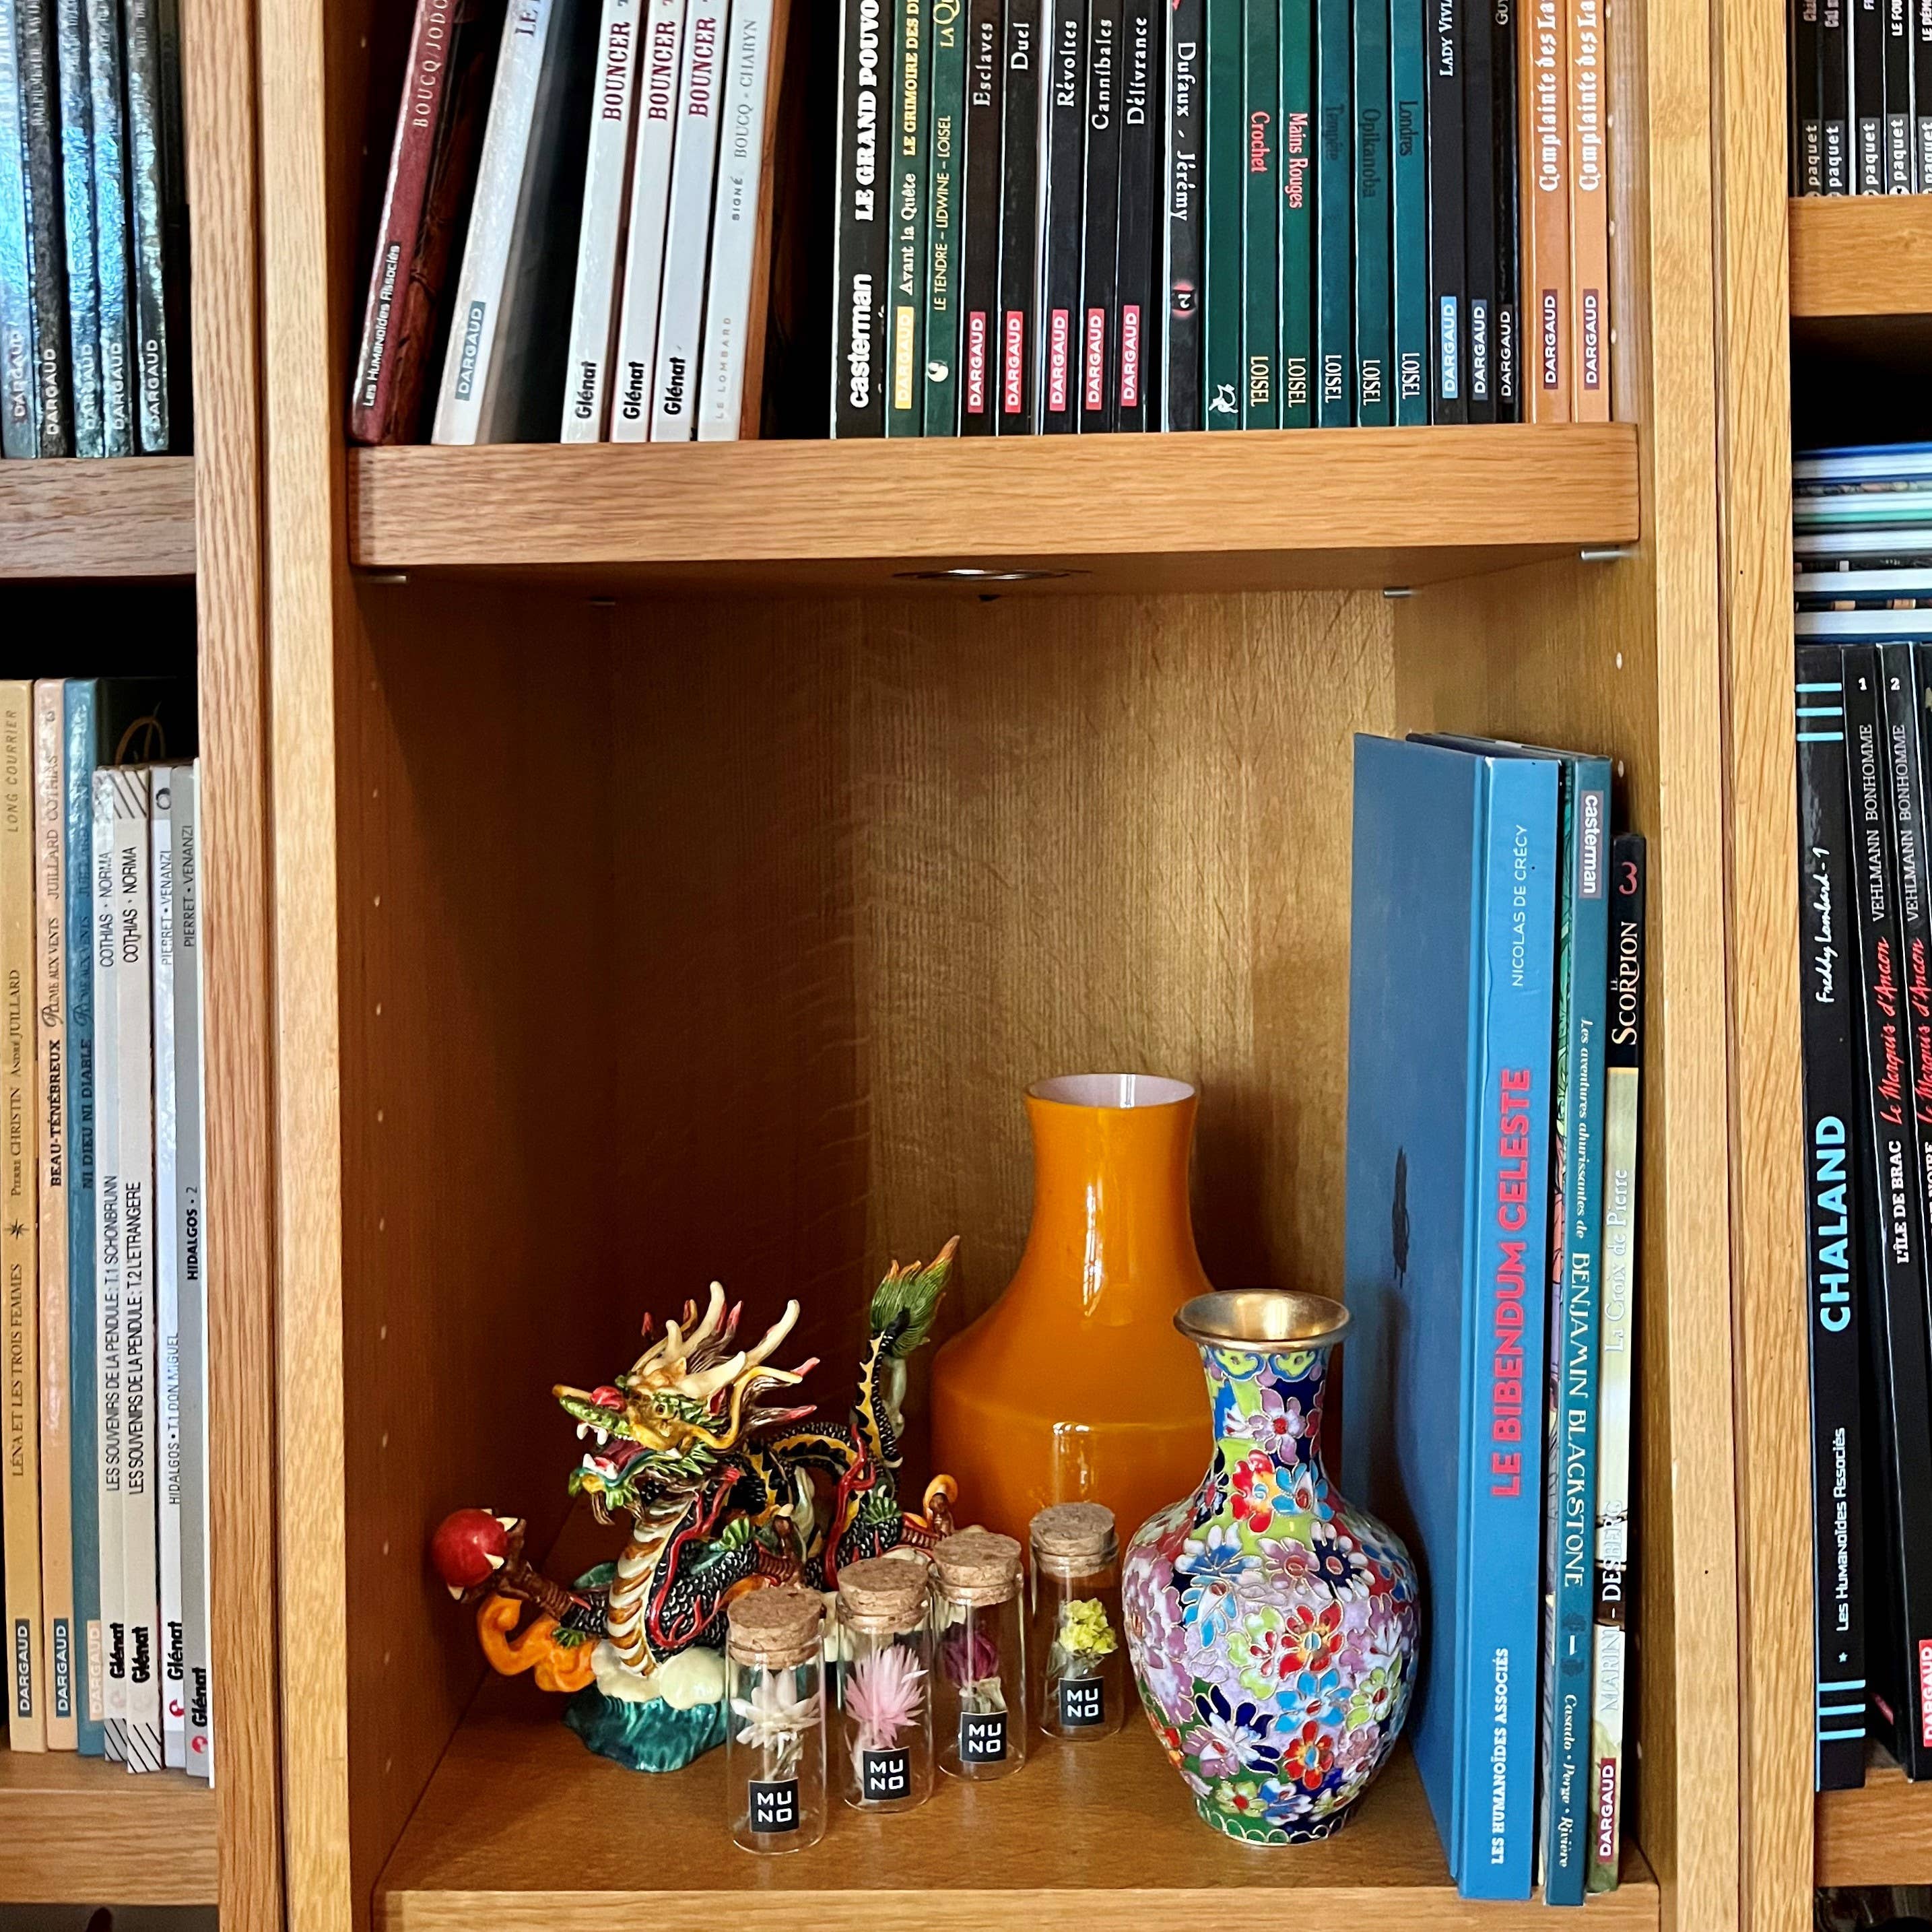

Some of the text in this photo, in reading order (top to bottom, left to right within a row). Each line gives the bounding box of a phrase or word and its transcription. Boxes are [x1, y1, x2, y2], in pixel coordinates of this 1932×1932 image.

[603, 22, 631, 121] BOUNCER
[648, 21, 676, 121] BOUNCER
[689, 17, 717, 117] BOUNCER
[940, 27, 954, 47] LA
[973, 22, 993, 106] Esclaves
[1011, 22, 1030, 71] Duel
[1056, 20, 1077, 107] Révoltes
[1126, 17, 1147, 125] Délivrance
[1440, 36, 1453, 77] LADY
[1891, 23, 1903, 36] LE
[734, 20, 757, 158] BOUCQ CHARYN
[855, 0, 879, 221] LE GRAND POUVO
[903, 18, 919, 156] LE GRIMOIRE DES
[1091, 19, 1112, 129] Cannibales
[1535, 34, 1562, 191] Complainte des
[1574, 32, 1602, 191] Complainte des
[1170, 42, 1196, 222] Dufaux Jérémy
[1251, 111, 1270, 173] Crochet
[1285, 112, 1308, 209] Mains Rouges
[1399, 101, 1418, 156] Londres
[1805, 125, 1820, 186] paquet
[1826, 125, 1842, 187] paquet
[1863, 123, 1879, 185] paquet
[1890, 119, 1907, 181] paquet
[899, 173, 916, 296] Avant la Quête
[934, 116, 951, 310] LE TENDRE LOISEL
[458, 308, 483, 394] DARGAUD
[719, 317, 731, 393] LOMBARD
[848, 273, 872, 408] casterman
[898, 314, 910, 402] DARGAUD
[970, 318, 984, 406] DARGAUD
[1007, 318, 1021, 406] DARGAUD
[1052, 315, 1065, 404] DARGAUD
[1088, 314, 1102, 403] DARGAUD
[1123, 312, 1137, 400] DARGAUD
[1250, 356, 1269, 407] LOISEL
[1288, 358, 1306, 408] LOISEL
[1325, 354, 1342, 403] LOISEL
[1362, 360, 1380, 406] LOISEL
[1401, 352, 1420, 400] LOISEL
[1443, 304, 1455, 392] DARGAUD
[1473, 306, 1486, 394] DARGAUD
[1500, 310, 1512, 397] DARGAUD
[1544, 295, 1556, 383] DARGAUD
[1585, 295, 1597, 384] DARGAUD
[43, 349, 59, 435] DARGAUD
[81, 343, 96, 430] DARGAUD
[110, 343, 125, 430] DARGAUD
[145, 339, 161, 432] DARGAUD
[575, 360, 597, 419] Glénat
[623, 361, 644, 420] Glénat
[664, 356, 686, 415] Glénat
[1859, 677, 1867, 690] 1
[1890, 677, 1900, 690] 2
[5, 710, 18, 833] LONG COURRIER
[46, 829, 59, 900] JUILLARD
[1584, 795, 1601, 894] casterman
[1859, 724, 1884, 922] VEHLMANN BONHOMME
[1893, 725, 1919, 922] VEHLMANN BONHOMME
[99, 852, 113, 967] COTHIAS NORMA
[122, 846, 139, 963] COTHIAS NORMA
[160, 851, 172, 965] PIERRET VENANZI
[182, 826, 195, 947] PIERRET VENANZI
[1512, 824, 1529, 987] NICOLAS DE CRÉCY
[1619, 861, 1638, 896] 3
[1816, 945, 1838, 1003] Freddy
[9, 970, 23, 1156] CHRISTIN JUILLARD
[1878, 1024, 1904, 1125] Le Marquis
[81, 1039, 93, 1189] NI DIEU NI DIABLE
[1576, 1018, 1593, 1239] Les aventures ahurissantes de
[1888, 1140, 1906, 1218] DE BRAC
[187, 1209, 198, 1280] HIDALGOS
[1604, 1170, 1628, 1352] La Croix de Pierre
[1816, 1116, 1851, 1332] CHALAND
[1491, 1068, 1531, 1497] LE BIBENDUM CELESTE
[10, 1263, 24, 1477] LÉNA ET LES TROIS FEMMES
[106, 1372, 120, 1492] LES DE
[128, 1375, 143, 1495] LES SOUVENIRS DE
[168, 1333, 180, 1504] HIDALGOS MIGUEL
[1564, 1252, 1591, 1587] BENJAMIN BLACKSTONE
[1832, 1427, 1848, 1631] Les Associés
[1601, 1500, 1623, 1711] MARINI DESBERG
[18, 1625, 30, 1711] DARGAUD
[57, 1625, 68, 1710] DARGAUD
[91, 1626, 103, 1714] DARGAUD
[110, 1622, 125, 1678] Glénat
[132, 1626, 149, 1683] Glénat
[168, 1622, 183, 1680] Glénat
[192, 1667, 207, 1727] Glénat
[968, 1722, 1002, 1737] MU
[1067, 1688, 1098, 1702] MU
[1067, 1703, 1099, 1717] NO
[1564, 1694, 1577, 1751] Casado
[869, 1759, 904, 1774] MU
[871, 1776, 904, 1791] NO
[968, 1739, 1001, 1754] NO
[1490, 1648, 1508, 1864] LES HUMANOÏDES ASSOCIÉS
[757, 1790, 793, 1805] MU
[758, 1807, 793, 1823] NO
[1600, 1764, 1614, 1857] DARGAUD
